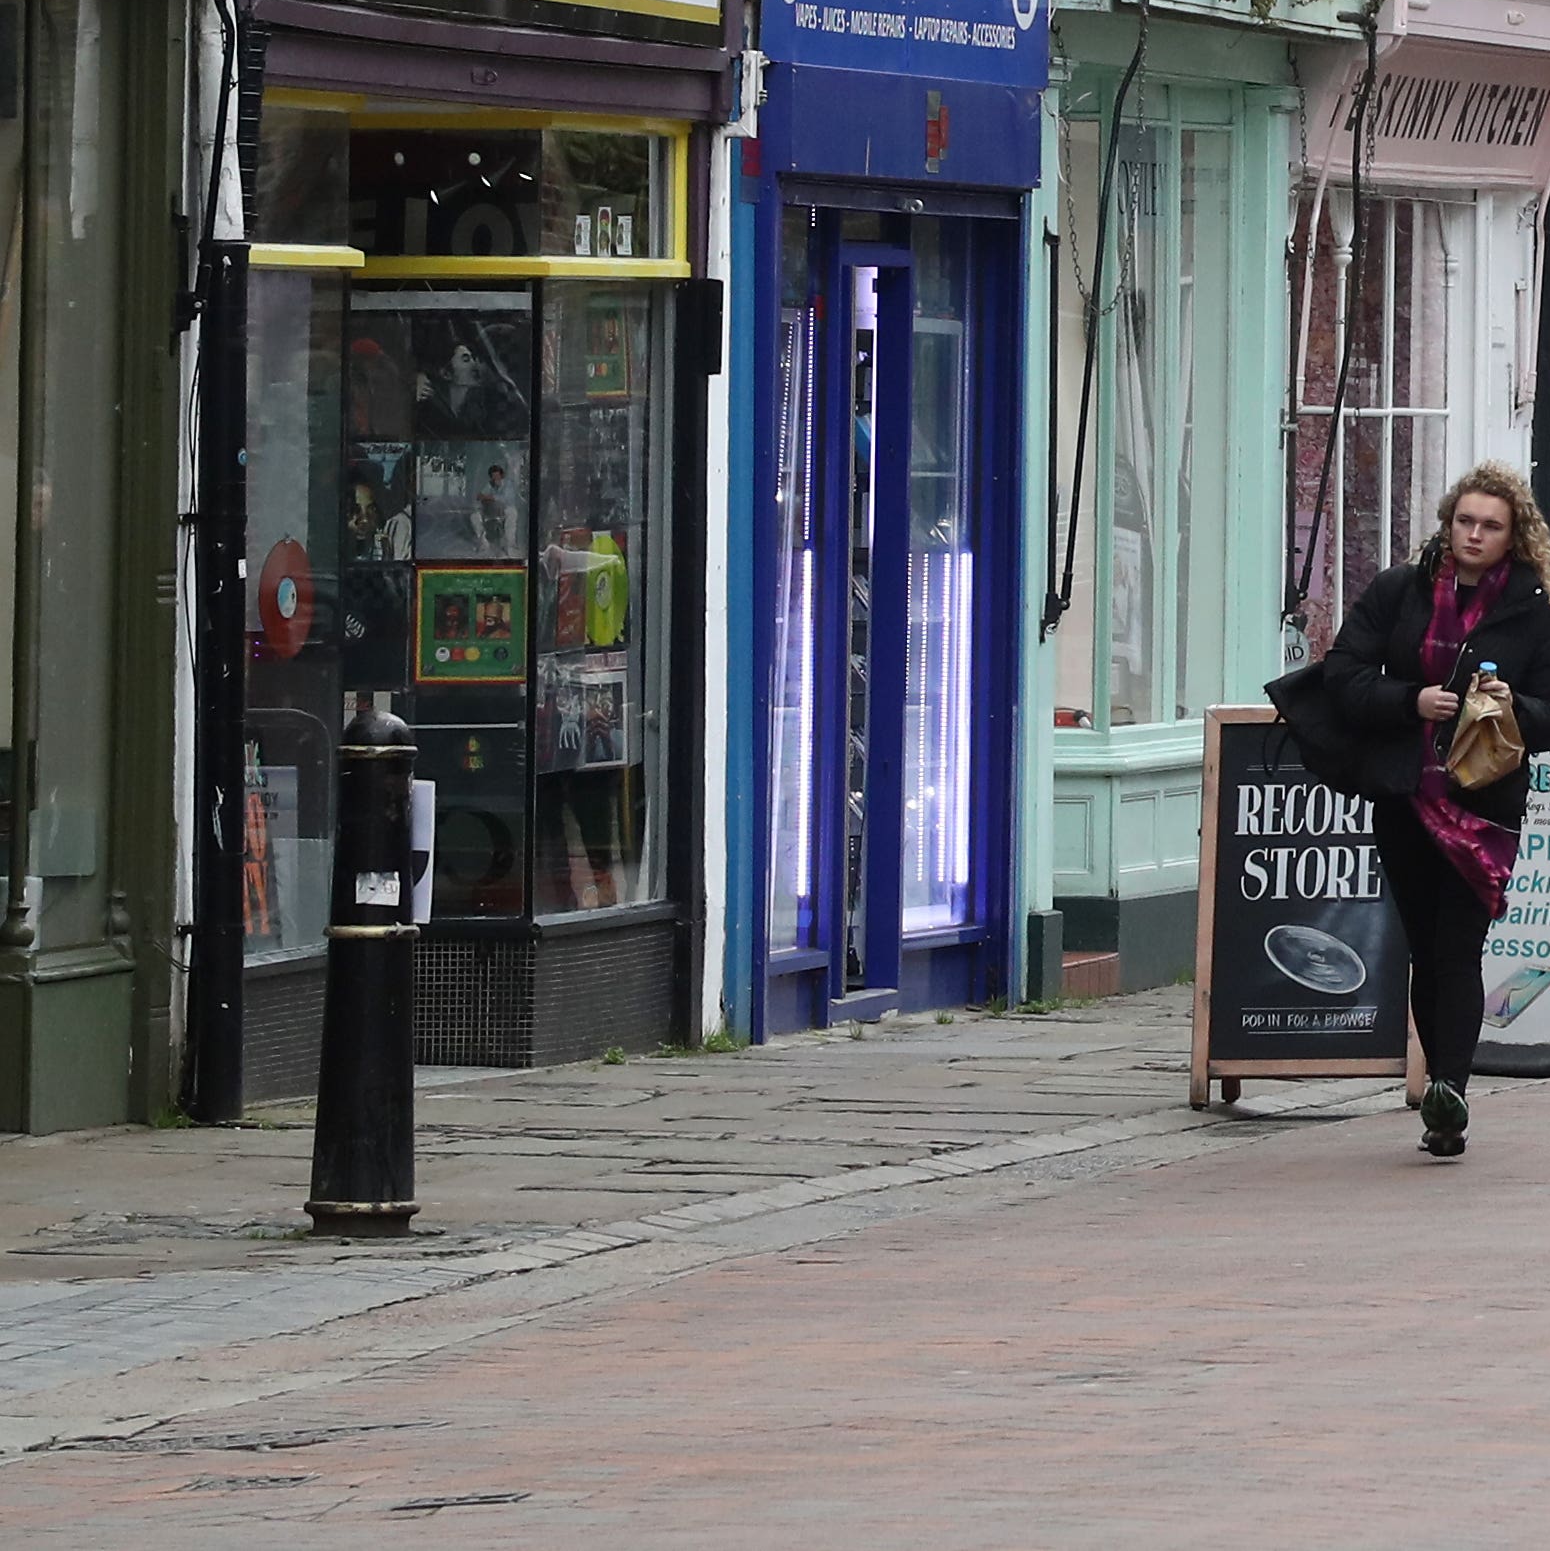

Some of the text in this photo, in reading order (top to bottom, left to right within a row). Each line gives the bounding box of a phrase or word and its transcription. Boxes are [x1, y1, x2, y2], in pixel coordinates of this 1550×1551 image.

[795, 2, 817, 29] VAPES
[822, 8, 845, 33] JUICES
[851, 11, 877, 37] MOBILE
[878, 13, 906, 39] REPAIRS
[914, 16, 940, 42] LAPTOP
[971, 22, 1016, 50] ACCESSORIES
[1241, 845, 1382, 901] STORE
[1242, 1011, 1378, 1028] POP IN FOR A BROWSE!
